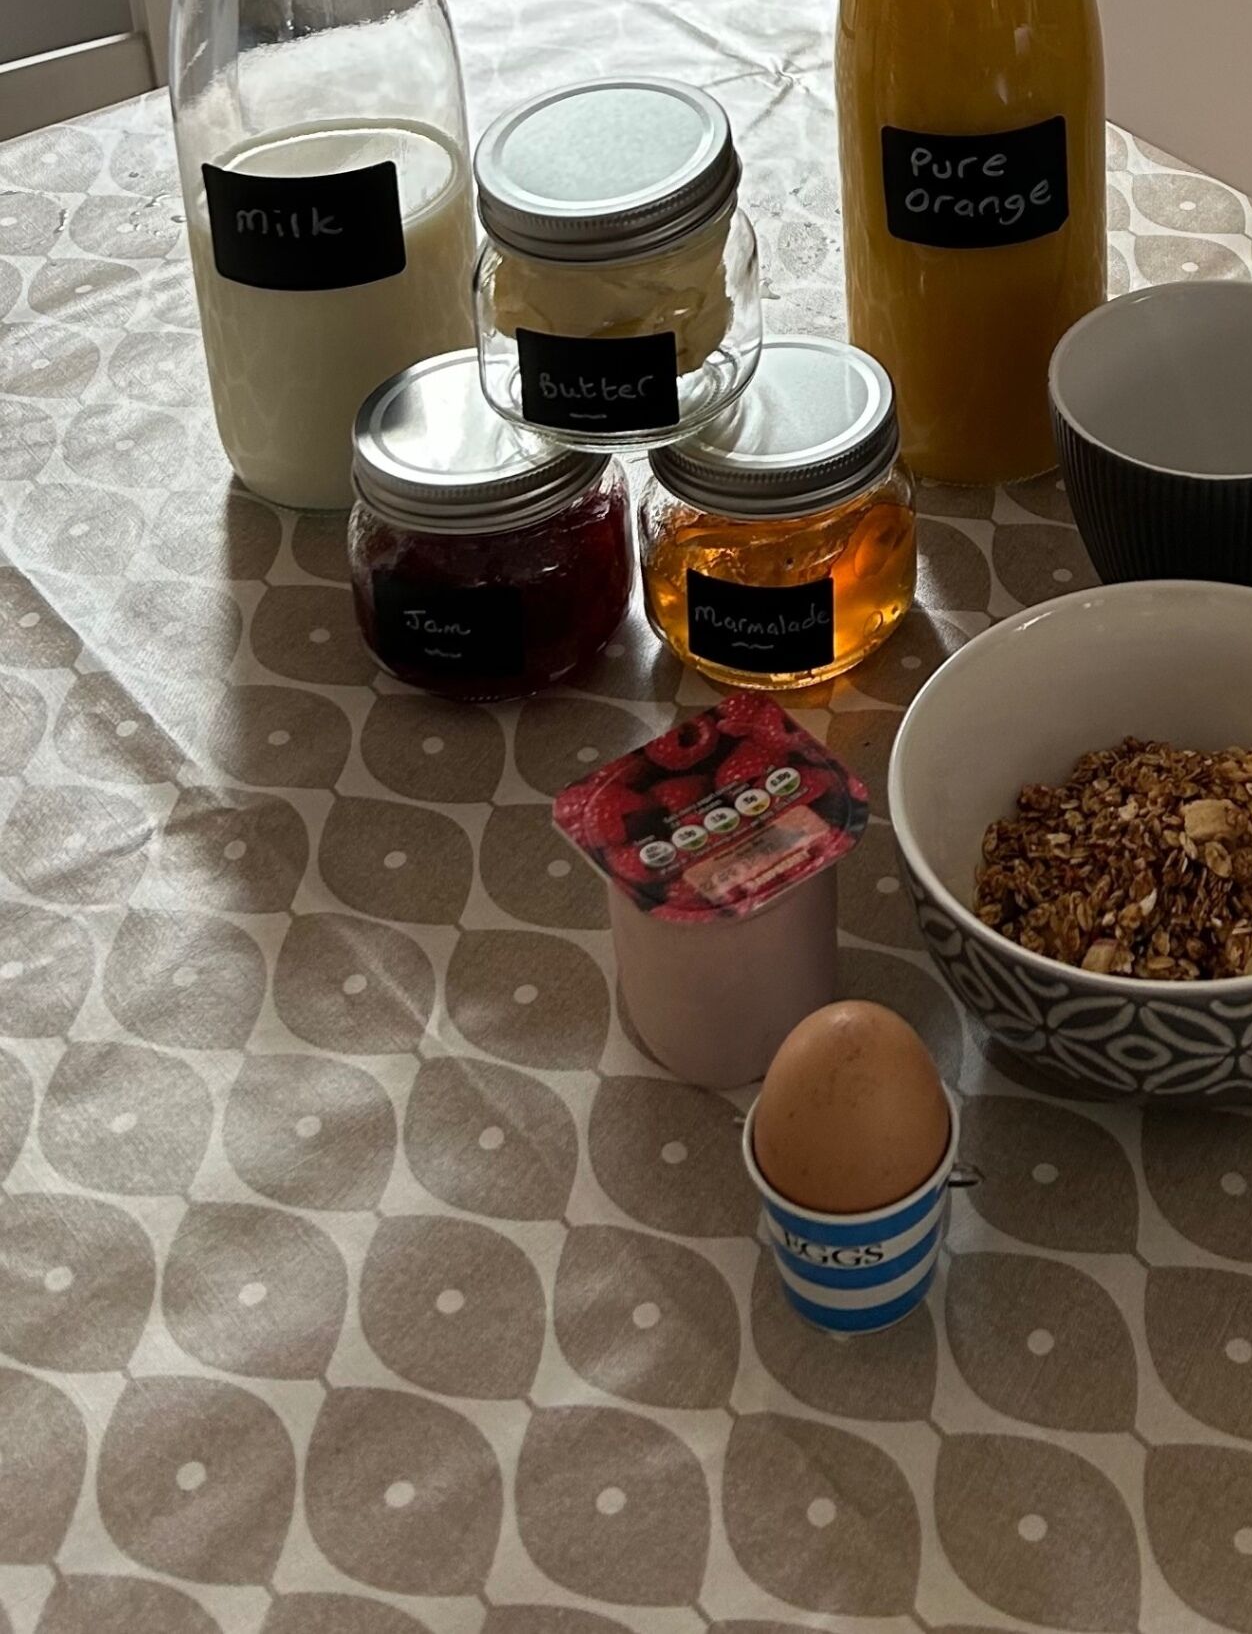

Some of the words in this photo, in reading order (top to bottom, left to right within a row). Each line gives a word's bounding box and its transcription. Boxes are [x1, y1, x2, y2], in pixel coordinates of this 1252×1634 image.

[910, 147, 1008, 180] Pure
[539, 371, 654, 401] Butter
[402, 609, 472, 636] Jam
